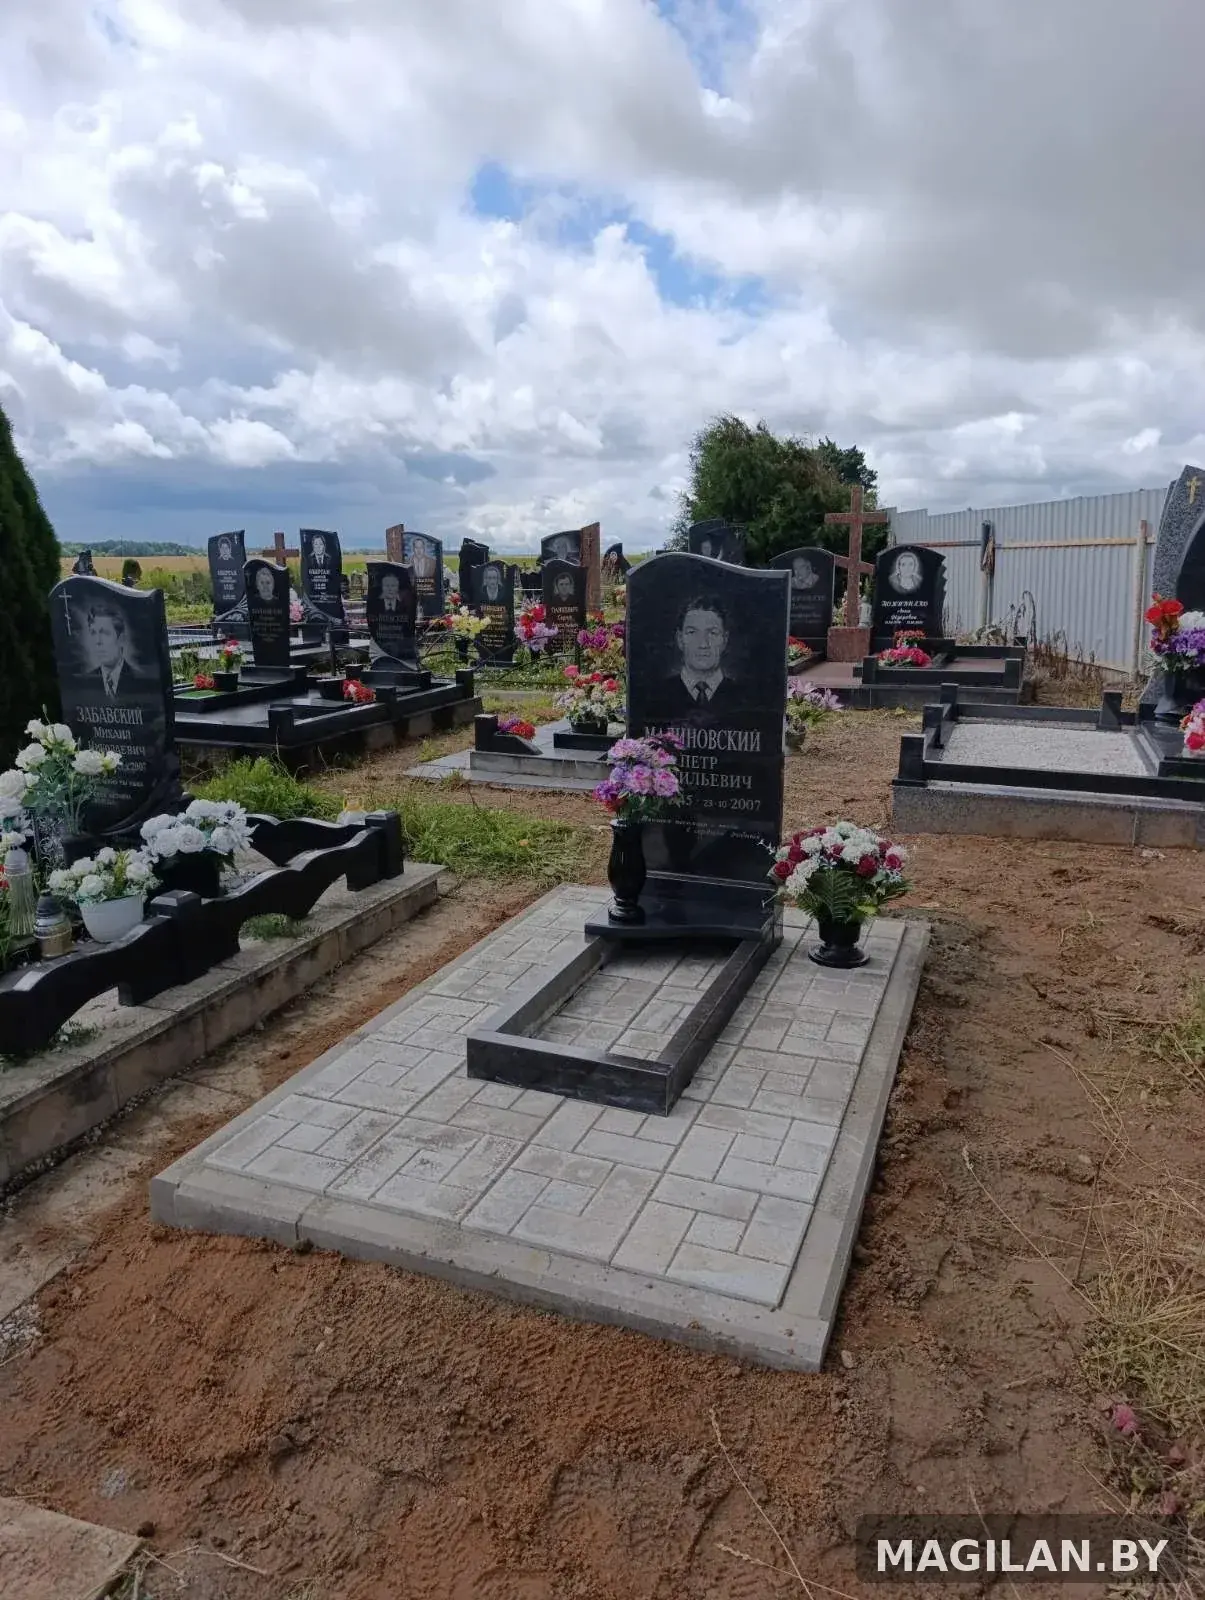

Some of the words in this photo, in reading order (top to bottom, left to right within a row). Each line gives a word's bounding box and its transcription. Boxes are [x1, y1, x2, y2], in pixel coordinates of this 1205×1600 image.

[76, 706, 143, 725] ЗАБАВСКИЙ
[680, 754, 718, 770] ПЕТР
[679, 771, 752, 789] ИЛЬЕВИЧ
